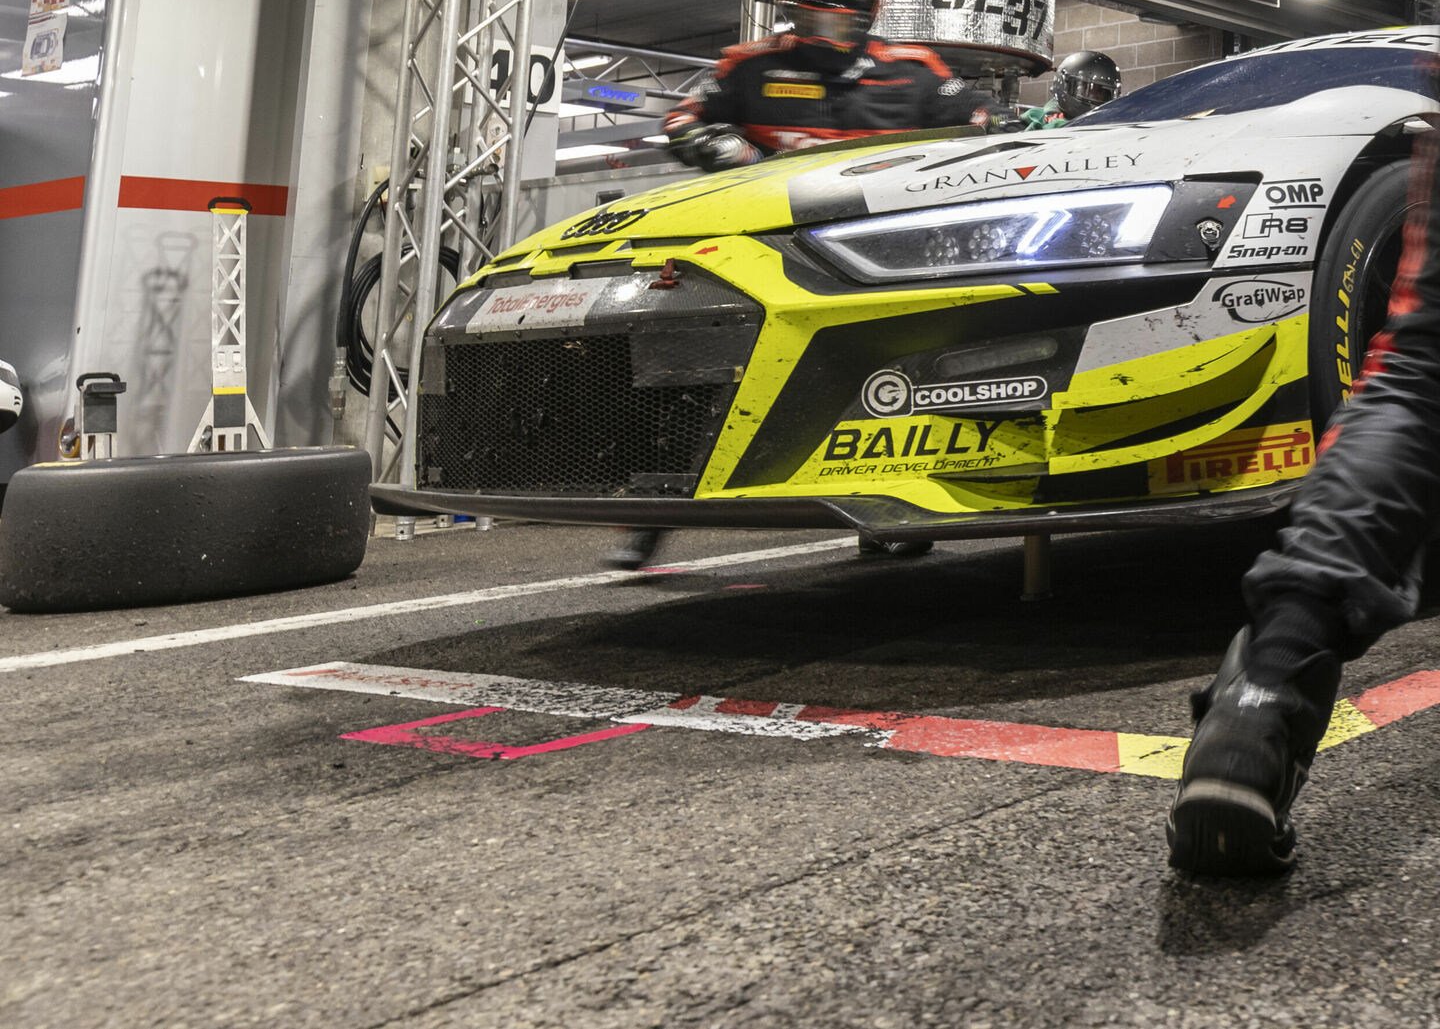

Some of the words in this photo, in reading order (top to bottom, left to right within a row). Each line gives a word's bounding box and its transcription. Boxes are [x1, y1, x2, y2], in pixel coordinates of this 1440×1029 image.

[905, 153, 1143, 192] GRANVALLEY
[1265, 184, 1324, 204] OMP
[1260, 217, 1308, 234] R8
[1227, 244, 1308, 259] Snap-on
[486, 288, 588, 314] TotalEnergies
[1222, 287, 1306, 308] GrafiWrap
[915, 381, 1038, 405] COOLSHOP
[823, 421, 1001, 461] BAILLY
[819, 464, 877, 477] DRIVER
[881, 457, 1001, 474] DEVELOPMENT
[1166, 431, 1311, 485] PIRELLI
